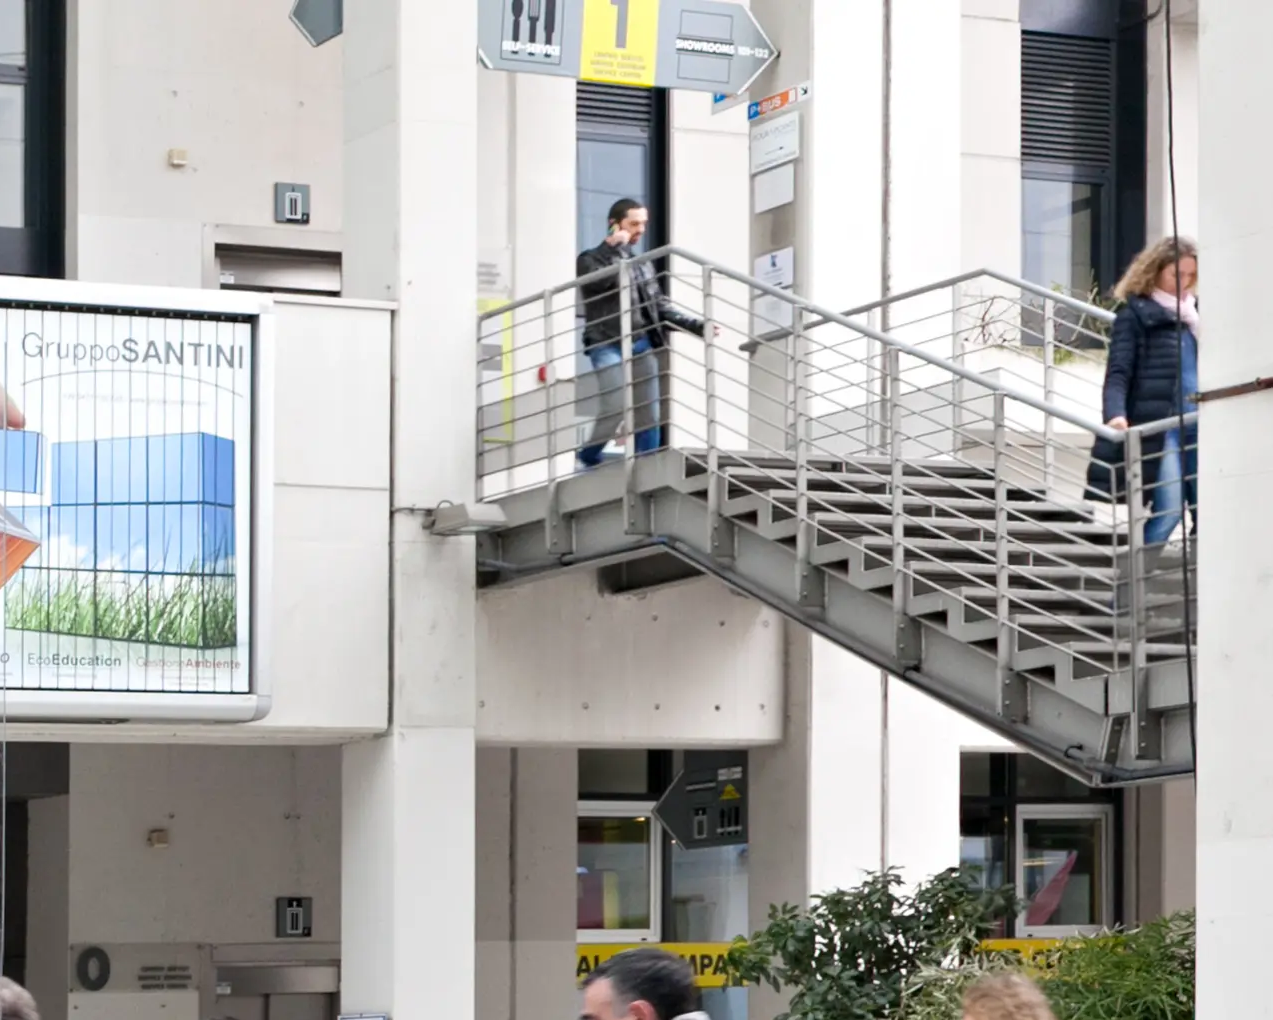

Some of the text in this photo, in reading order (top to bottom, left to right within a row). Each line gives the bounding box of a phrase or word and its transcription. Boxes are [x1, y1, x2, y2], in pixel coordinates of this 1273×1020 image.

[502, 40, 561, 56] SELF-SERVICE
[675, 39, 735, 54] SHOWROOMS
[21, 331, 244, 370] GruppoSANTINI
[27, 652, 122, 668] EcoEducation
